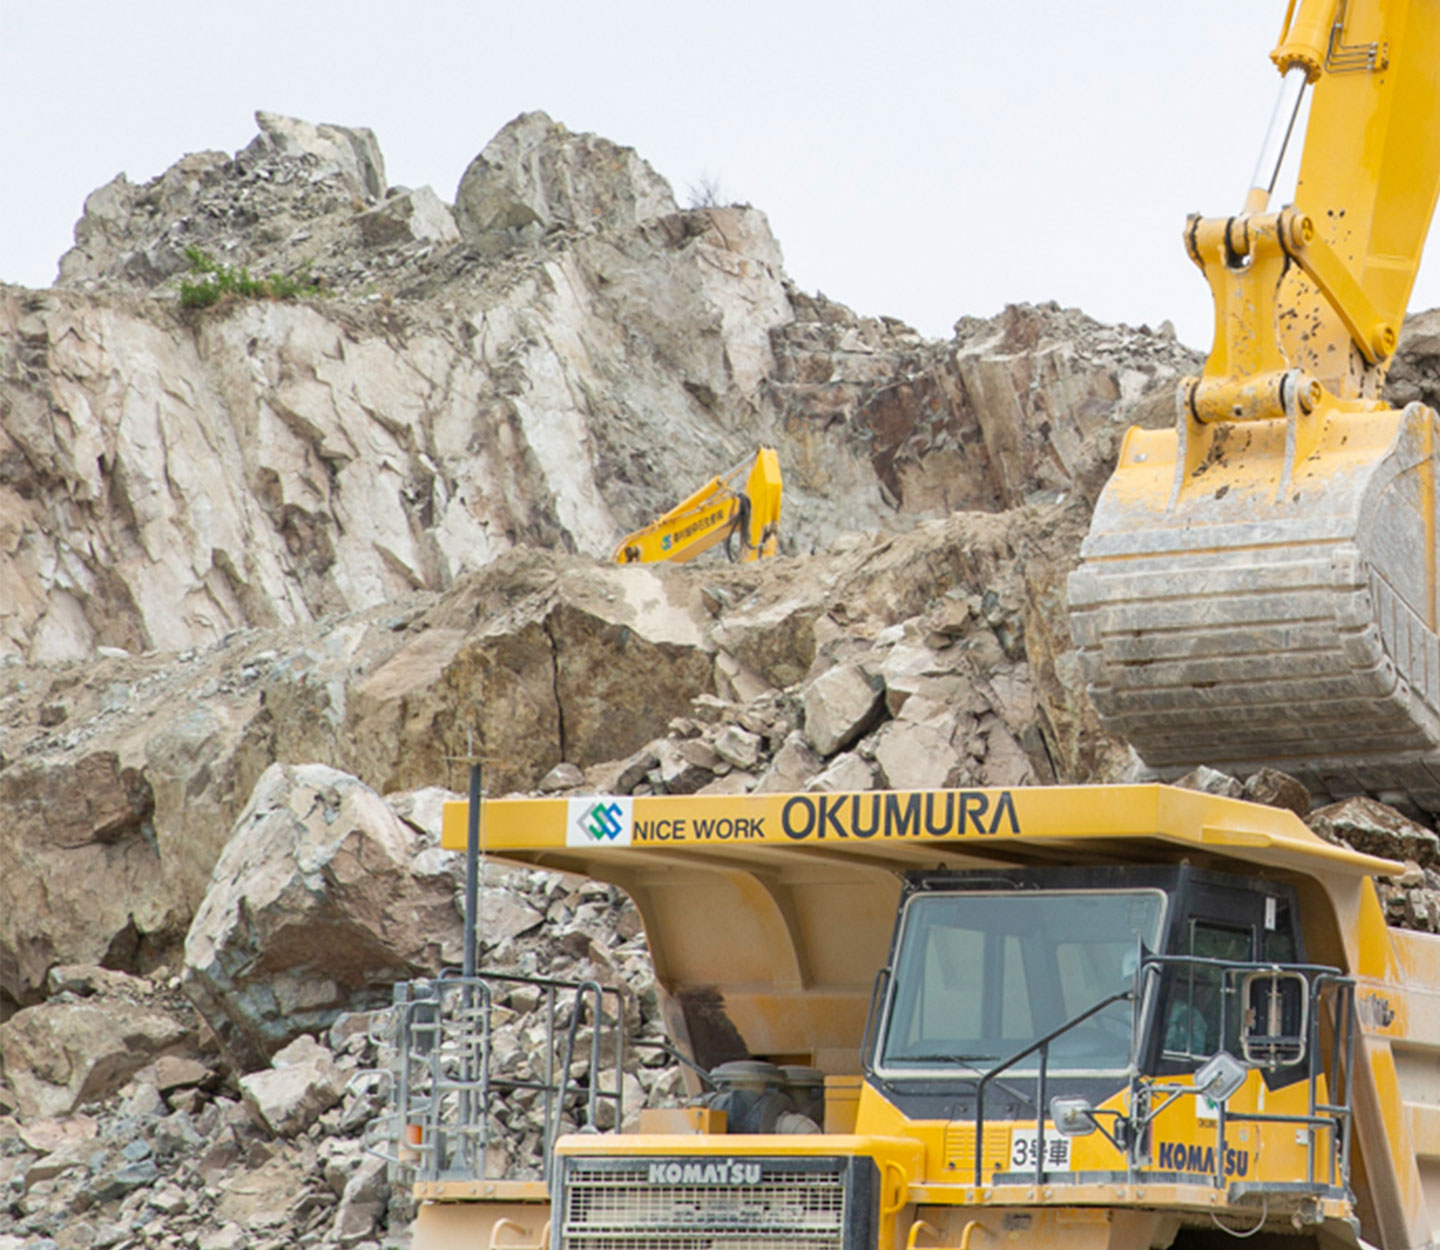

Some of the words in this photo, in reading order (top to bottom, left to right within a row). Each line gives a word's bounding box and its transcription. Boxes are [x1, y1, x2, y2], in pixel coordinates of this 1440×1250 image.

[632, 819, 687, 841] NICE
[692, 817, 766, 840] WORK
[781, 791, 1021, 840] OKUMURA
[648, 1158, 761, 1185] KOMATSU
